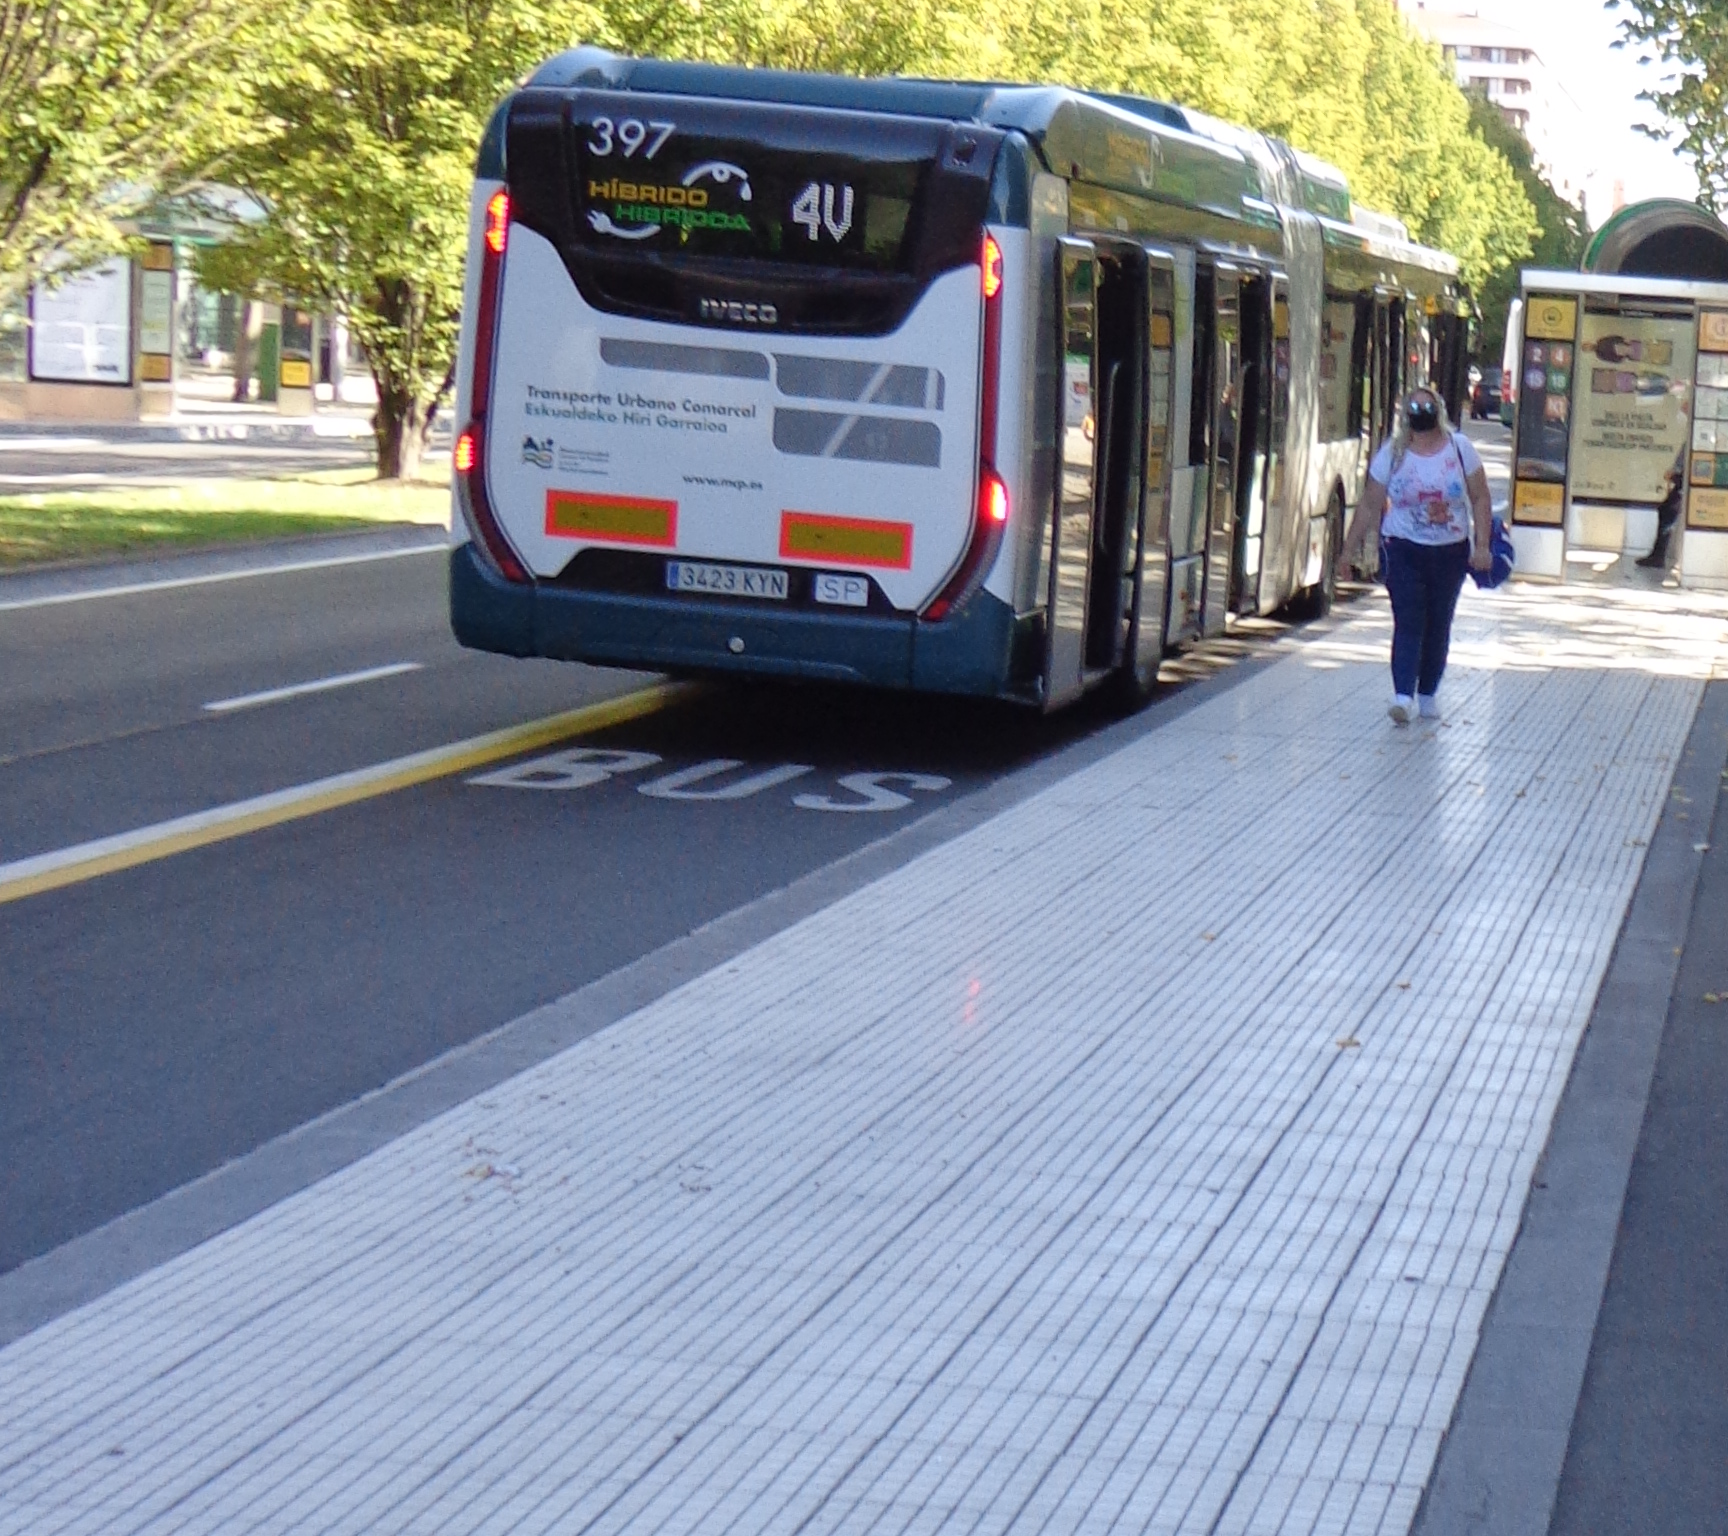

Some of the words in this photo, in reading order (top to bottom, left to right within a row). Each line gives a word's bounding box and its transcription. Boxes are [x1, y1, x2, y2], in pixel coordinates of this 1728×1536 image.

[587, 117, 677, 159] 397
[588, 177, 709, 207] HÍBRIDO
[701, 298, 778, 324] IVECO
[527, 385, 612, 405] Transporte
[617, 393, 677, 411] Urbano
[682, 398, 757, 418] Comarcal
[683, 567, 736, 590] 3423
[742, 572, 784, 595] KYN
[823, 578, 860, 600] SP
[464, 747, 953, 812] BUS
